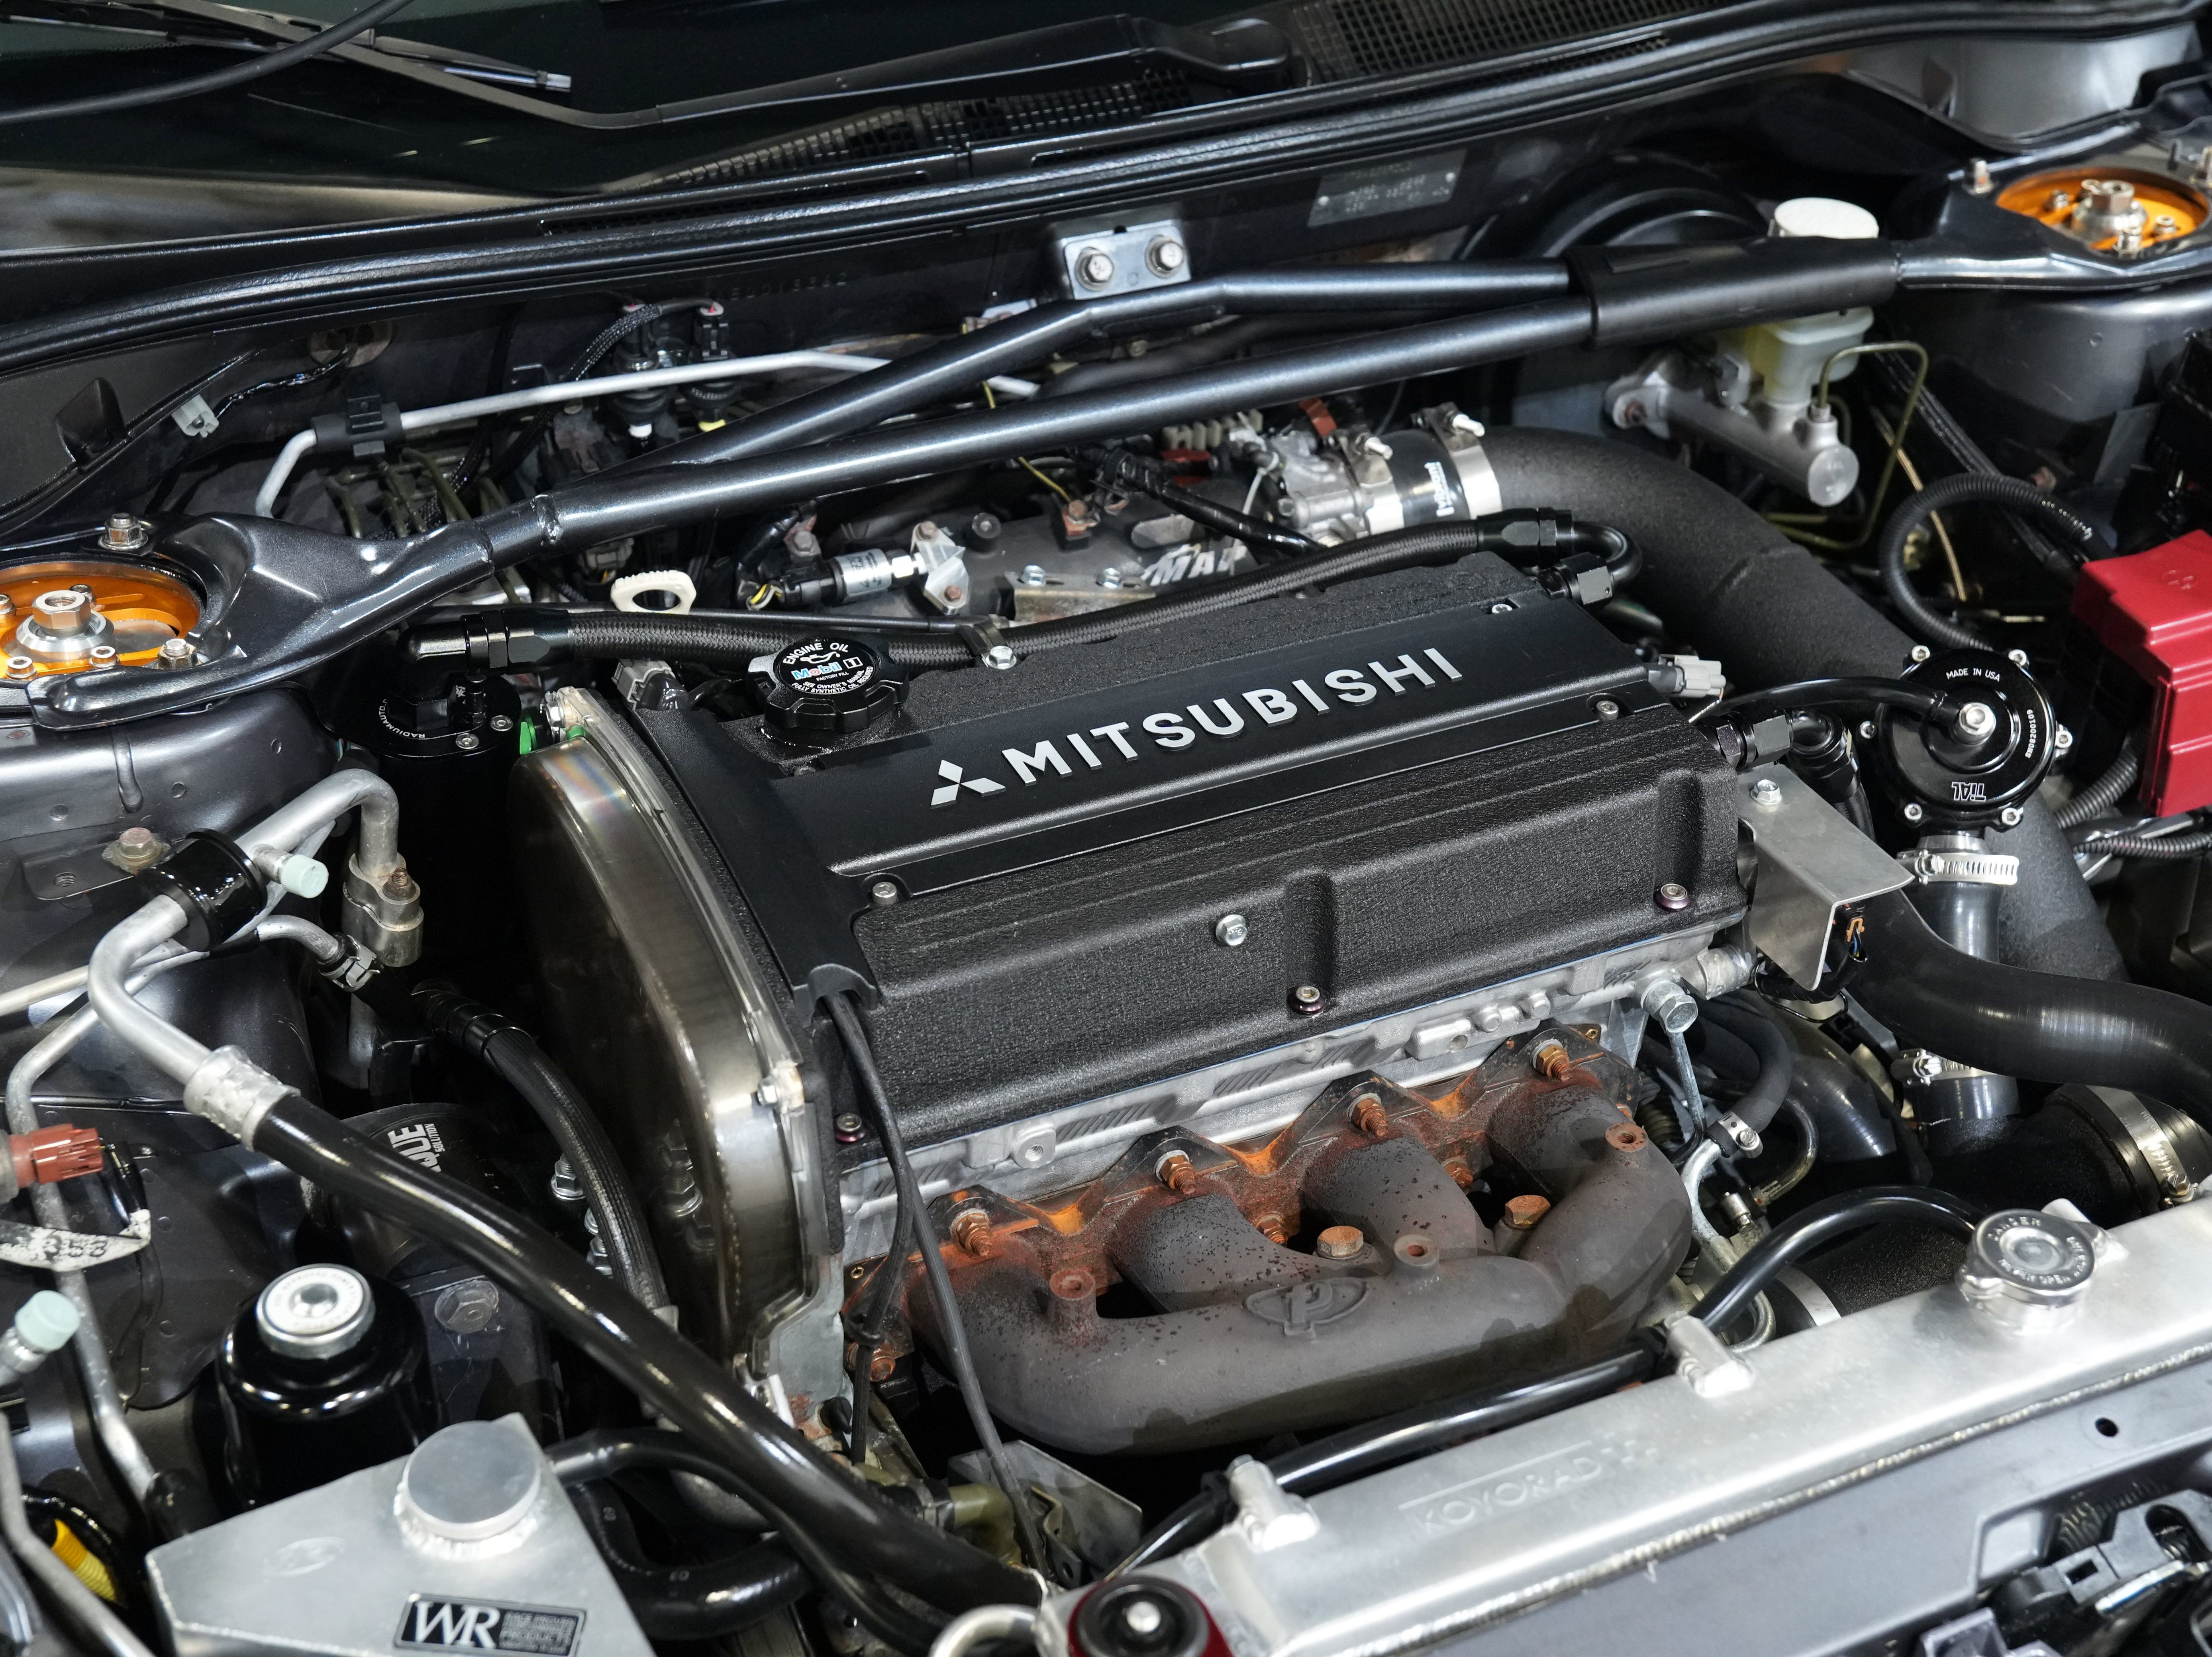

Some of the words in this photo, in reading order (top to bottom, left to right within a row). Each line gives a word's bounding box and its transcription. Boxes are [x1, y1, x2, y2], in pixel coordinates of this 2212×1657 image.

[782, 642, 824, 664] ENGINE
[830, 642, 848, 652] OIL
[791, 662, 843, 680] Mobil
[792, 682, 810, 691] FULLY
[857, 666, 873, 684] REQUIRED
[847, 670, 865, 684] MANUAL
[1946, 668, 1969, 680] MADE
[1985, 670, 2000, 682] USA
[1001, 648, 1463, 786] MITSUBISHI
[387, 1124, 441, 1173] QUE
[424, 1123, 446, 1153] SOLUTION
[1412, 1457, 1602, 1532] KOYORAD
[415, 1601, 501, 1649] WR
